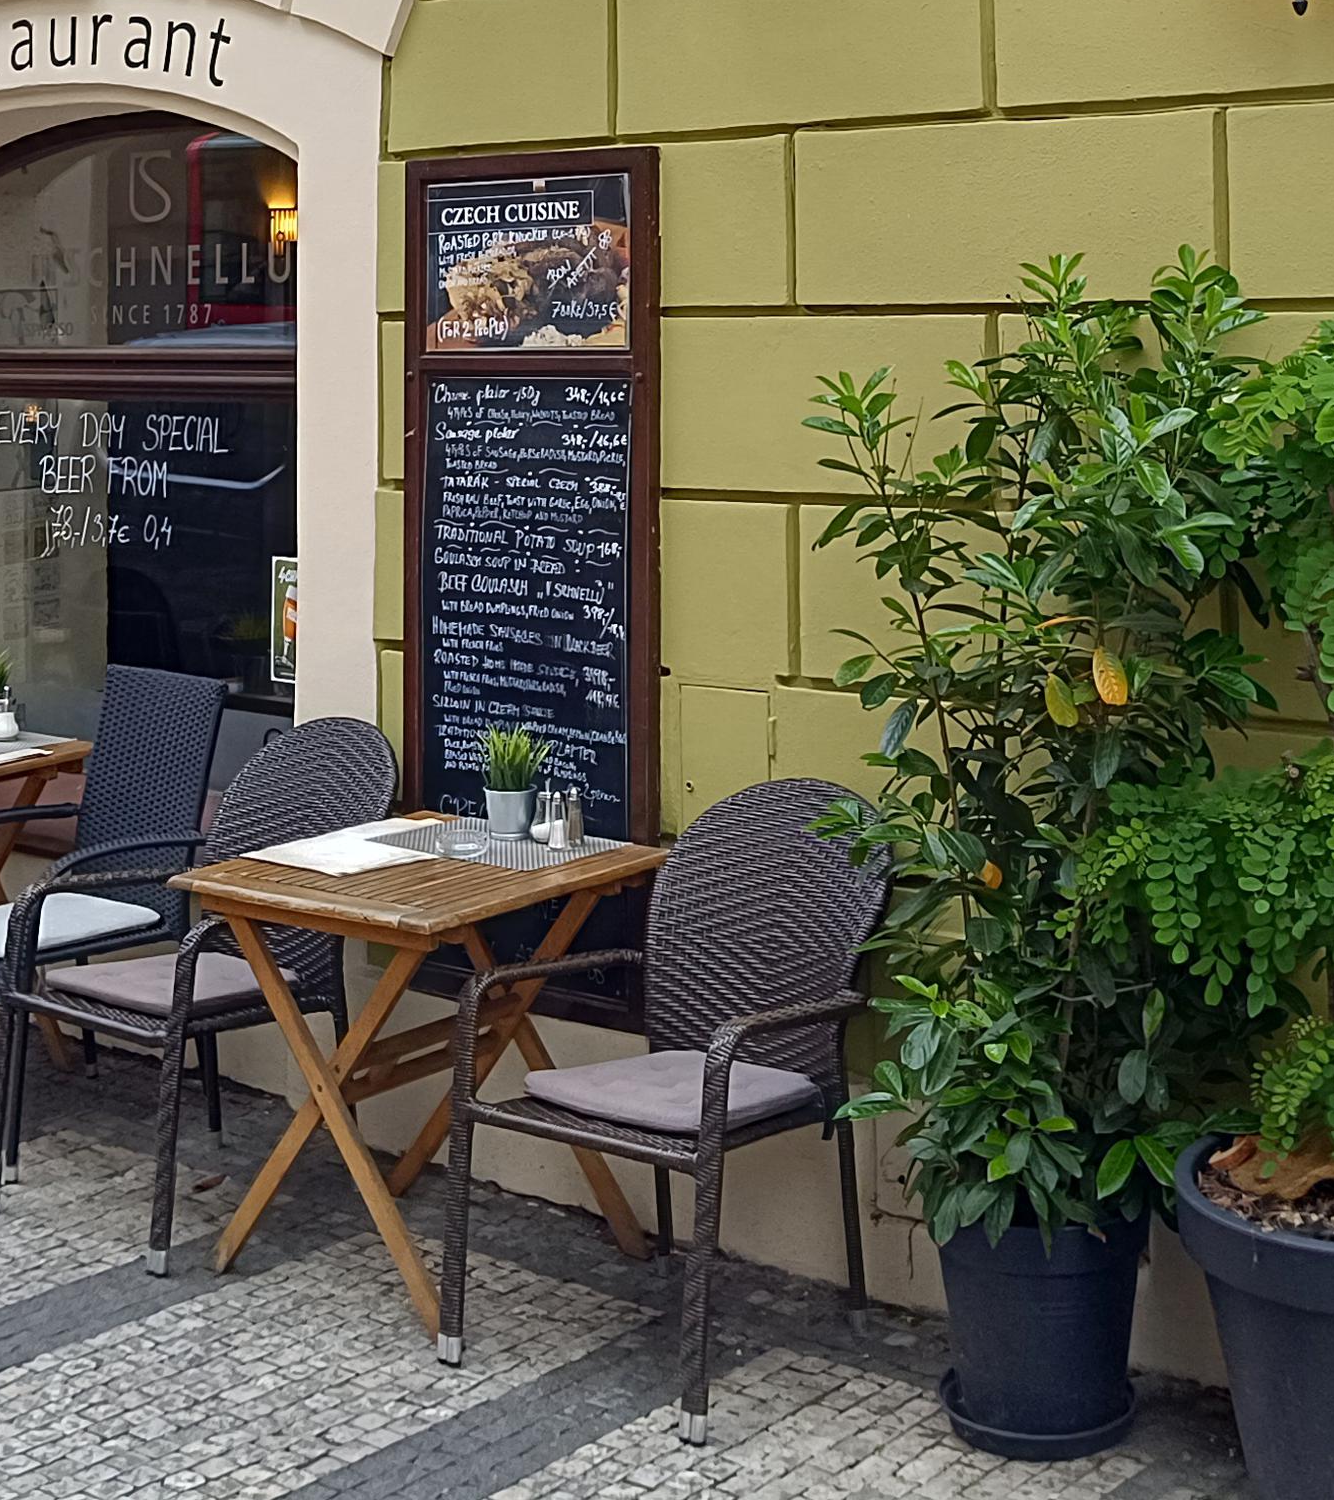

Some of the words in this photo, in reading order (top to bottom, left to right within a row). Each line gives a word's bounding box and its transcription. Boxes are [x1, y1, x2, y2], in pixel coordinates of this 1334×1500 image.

[441, 204, 500, 226] CZECH
[505, 200, 580, 222] CUISINE
[163, 303, 212, 325] 1787
[80, 412, 126, 449] DAY
[142, 414, 229, 454] SPECIAL
[39, 454, 97, 495] BEER
[107, 456, 167, 498] FROM
[143, 514, 172, 550] 0,4
[434, 524, 509, 545] TRADITIONAL
